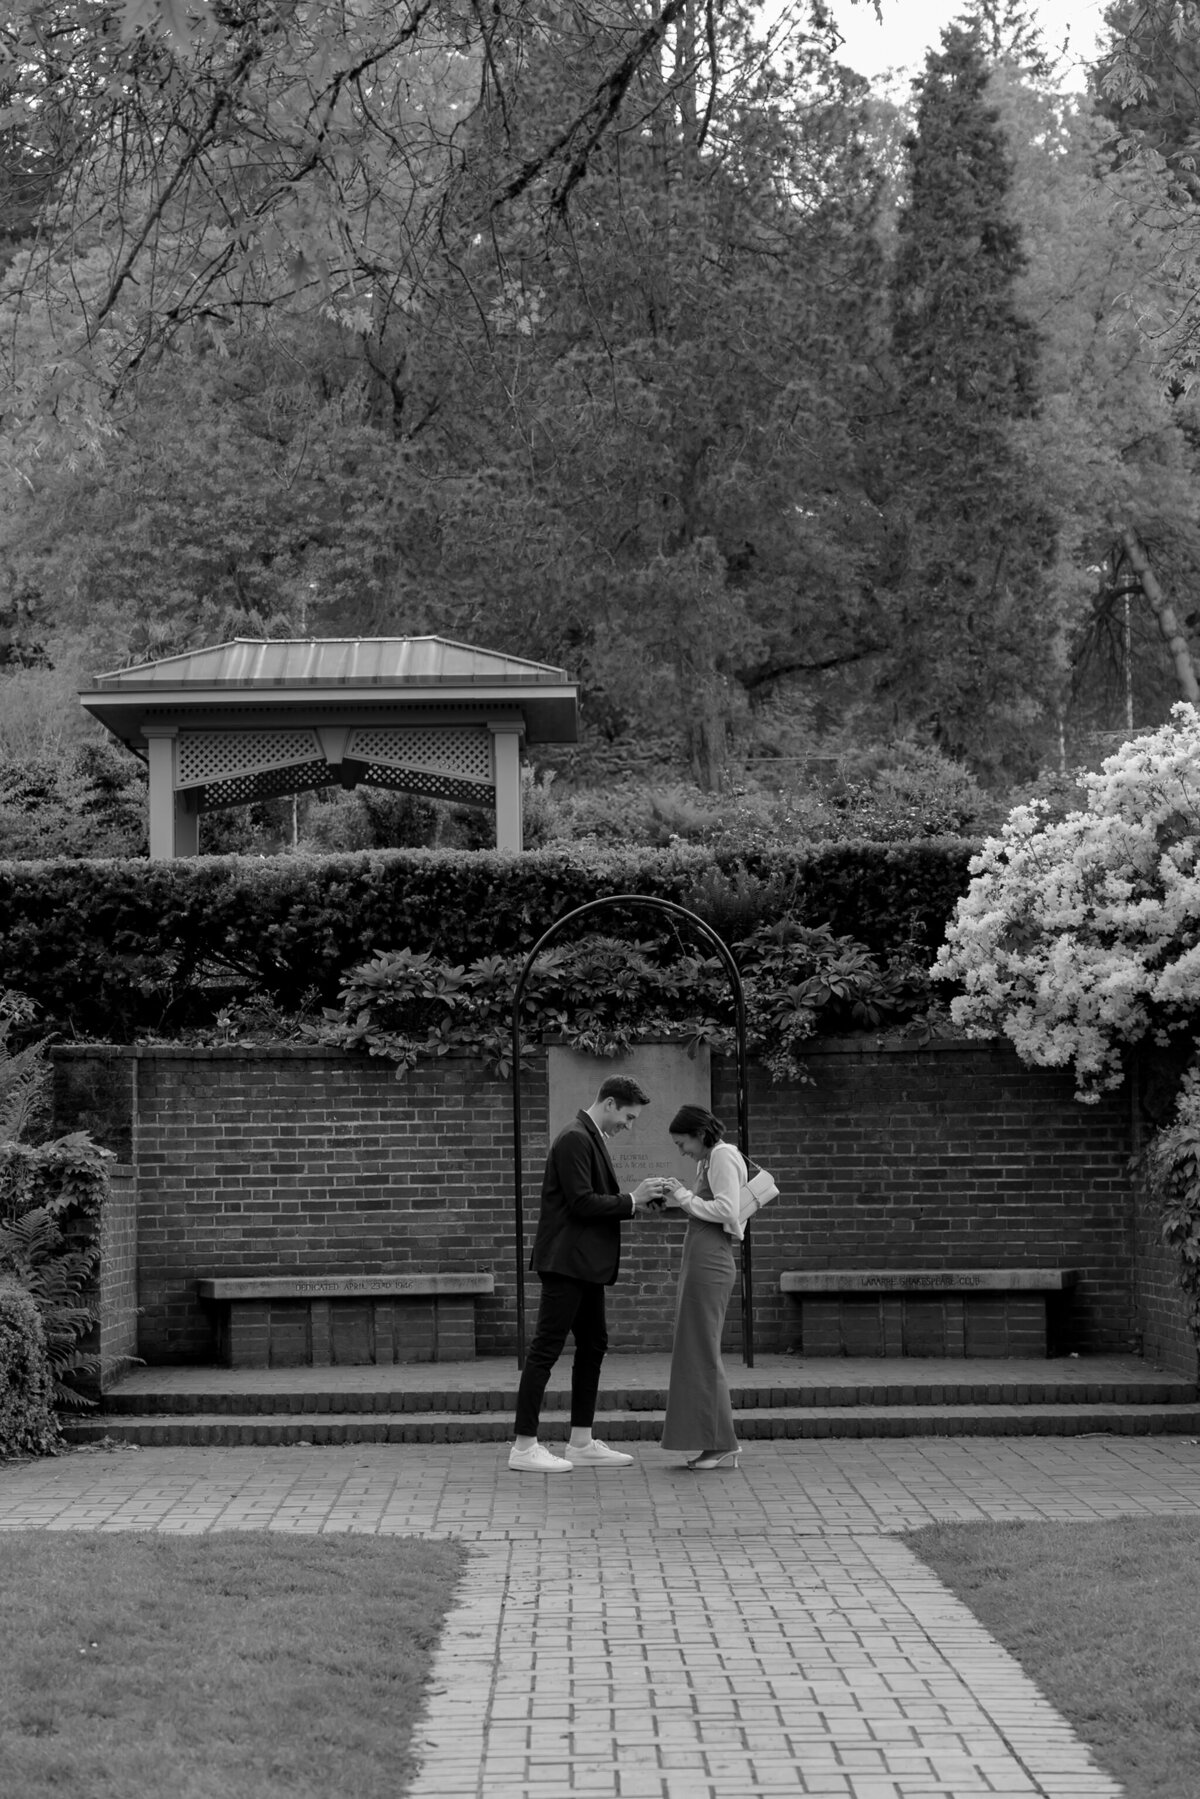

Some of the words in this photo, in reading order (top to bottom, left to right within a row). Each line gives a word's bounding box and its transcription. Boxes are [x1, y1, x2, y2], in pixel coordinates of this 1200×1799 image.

[631, 1161, 647, 1169] ROSE
[899, 1276, 954, 1286] SHAKESPEARE
[959, 1276, 980, 1286] CLUB
[295, 1283, 339, 1292] DEDICATED
[344, 1282, 368, 1291] APRIL
